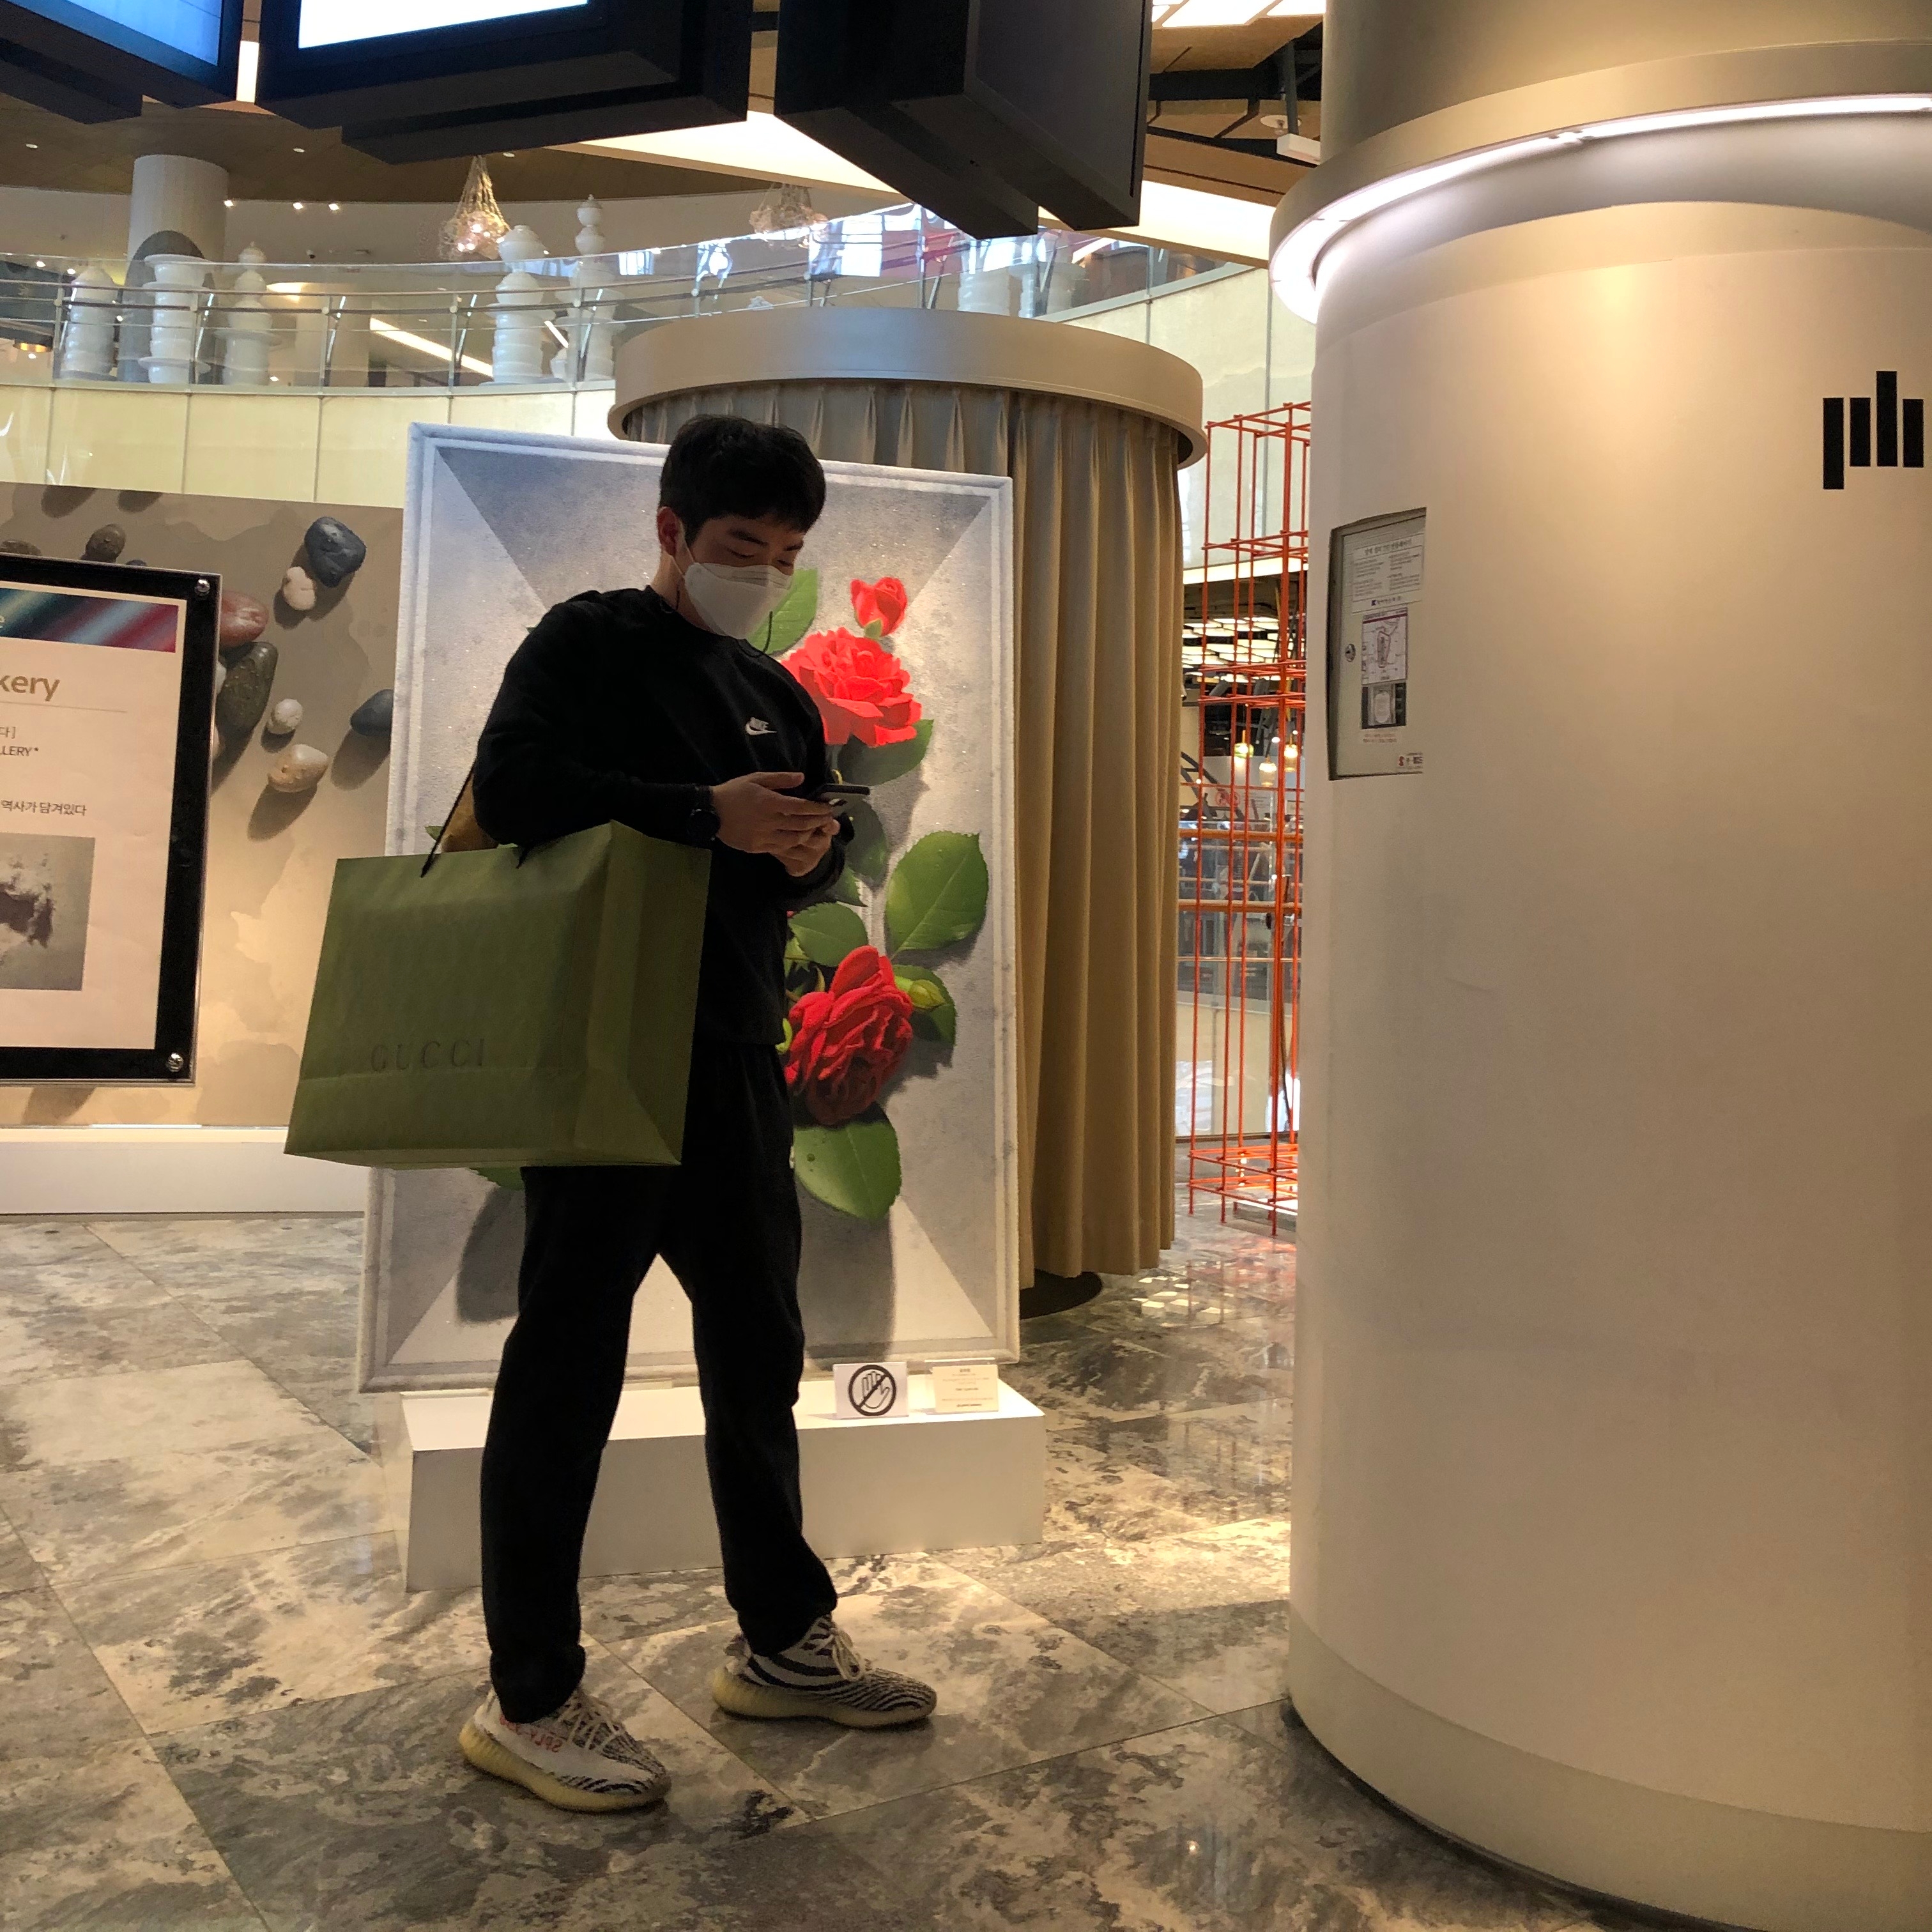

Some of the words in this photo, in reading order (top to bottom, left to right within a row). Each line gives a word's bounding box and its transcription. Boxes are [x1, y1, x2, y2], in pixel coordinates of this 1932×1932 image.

[1, 800, 37, 813] 역사가
[39, 802, 87, 816] 담겨있다
[371, 1038, 485, 1072] GUCCI
